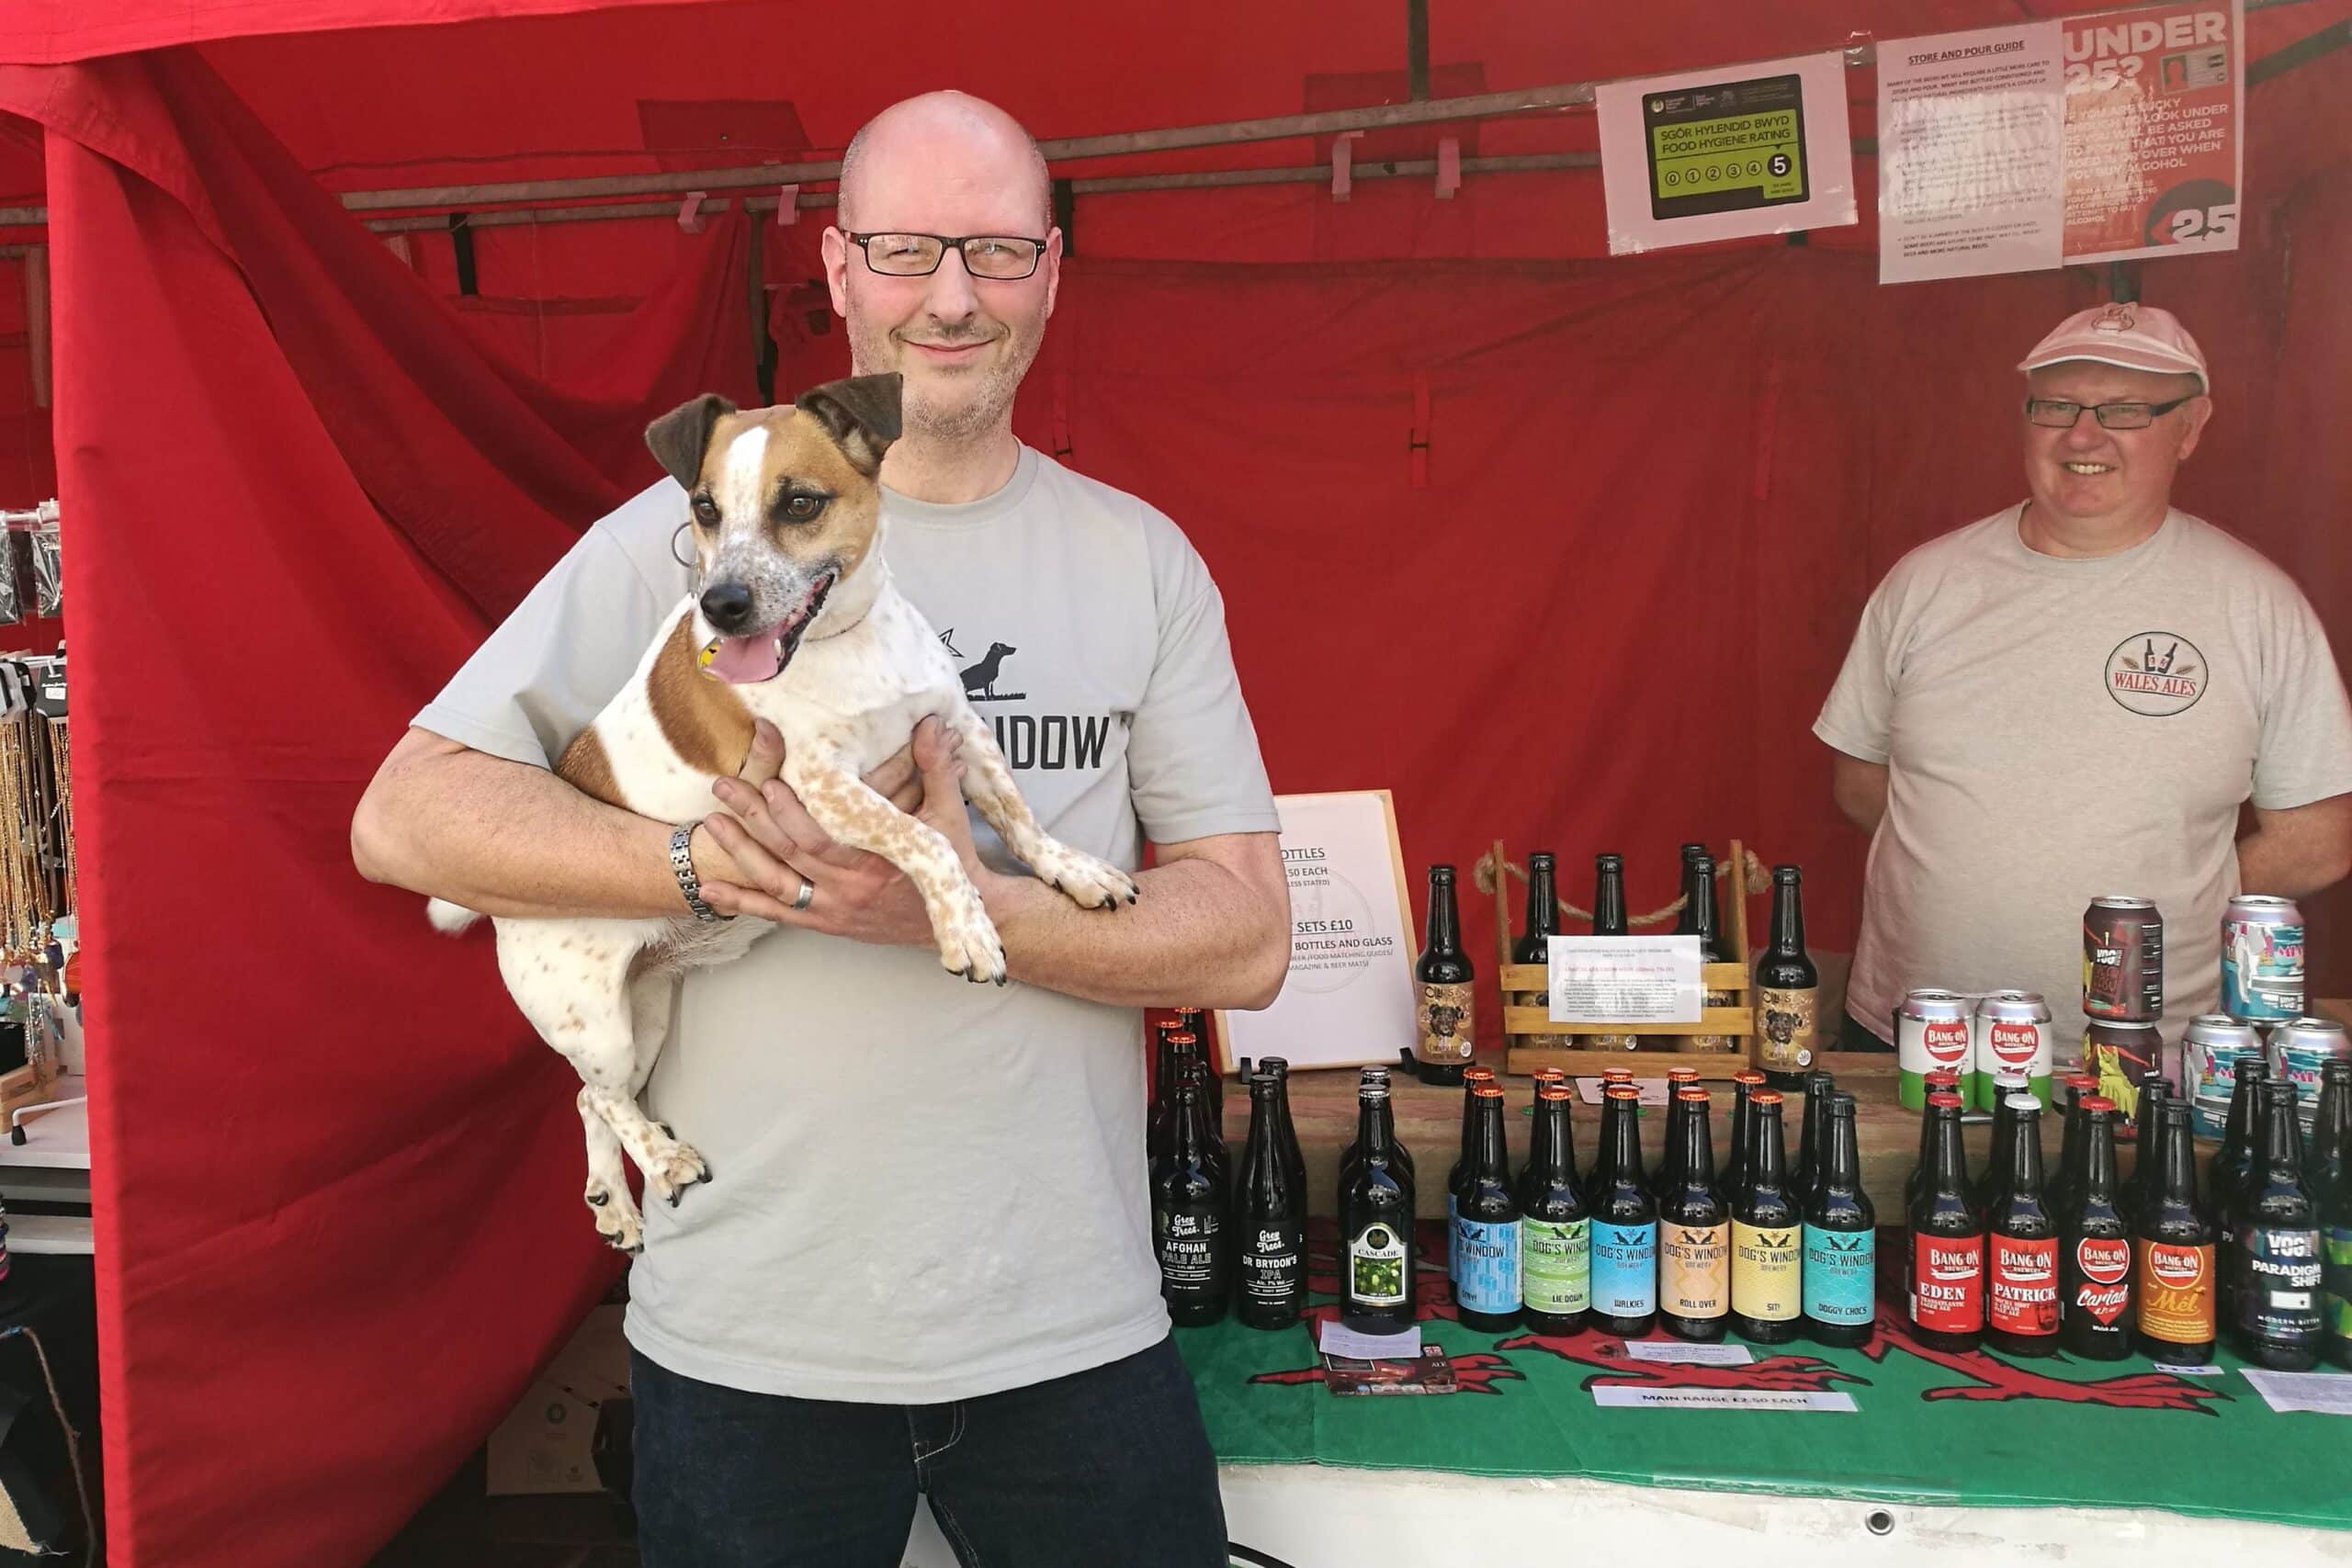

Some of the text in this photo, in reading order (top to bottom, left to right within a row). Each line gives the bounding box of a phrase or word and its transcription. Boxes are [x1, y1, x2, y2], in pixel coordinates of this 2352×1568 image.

[2064, 12, 2227, 62] UNDER
[1908, 40, 2025, 64] STORE AND POUR GUIDE
[2064, 55, 2143, 95] 25?
[2183, 104, 2228, 118] UNDER
[1695, 119, 1751, 136] HYLENDID
[1755, 116, 1790, 129] BWYD
[2168, 118, 2211, 132] ASKED
[1662, 129, 1790, 153] FOOD HYGIENE RATING
[2167, 131, 2195, 143] YOU
[2198, 128, 2225, 140] ARE
[2142, 147, 2177, 159] OVER
[2179, 141, 2222, 154] WHEN
[1773, 157, 1786, 175] 5
[2126, 158, 2188, 173] ALCOHOL
[2172, 204, 2236, 244] 25
[2115, 671, 2197, 696] WALES ALES
[995, 716, 1110, 770] DOW
[1280, 848, 1325, 860] OTTLES
[1303, 867, 1328, 876] EACH
[1297, 919, 1353, 933] SETS £10
[1295, 937, 1393, 951] BOTTLES AND GLASS
[1166, 1241, 1207, 1253] AFGHAN
[1358, 1249, 1398, 1258] CASCADE
[1465, 1241, 1505, 1258] WINDOW
[1532, 1240, 1561, 1255] DOG'S
[1595, 1244, 1623, 1260] DOG'S
[1665, 1243, 1690, 1259] DOG'S
[1738, 1246, 1767, 1262] DOG'S
[1161, 1251, 1211, 1265] PALE ALE
[1255, 1255, 1297, 1269] BRYDON'S
[1809, 1248, 1837, 1266] DOG'S
[1261, 1269, 1281, 1280] IPA
[2252, 1259, 2322, 1277] PARADIGM
[2291, 1274, 2321, 1288] SHIFT
[1553, 1293, 1583, 1303] LIE DOWN
[1920, 1282, 1966, 1301] EDEN
[1995, 1282, 2056, 1303] PATRICK
[2076, 1283, 2129, 1306] Cariad
[1613, 1300, 1645, 1308] WALKIES
[1679, 1299, 1716, 1308] ROLL OVER
[1818, 1303, 1867, 1315] DOGGY CHOCS
